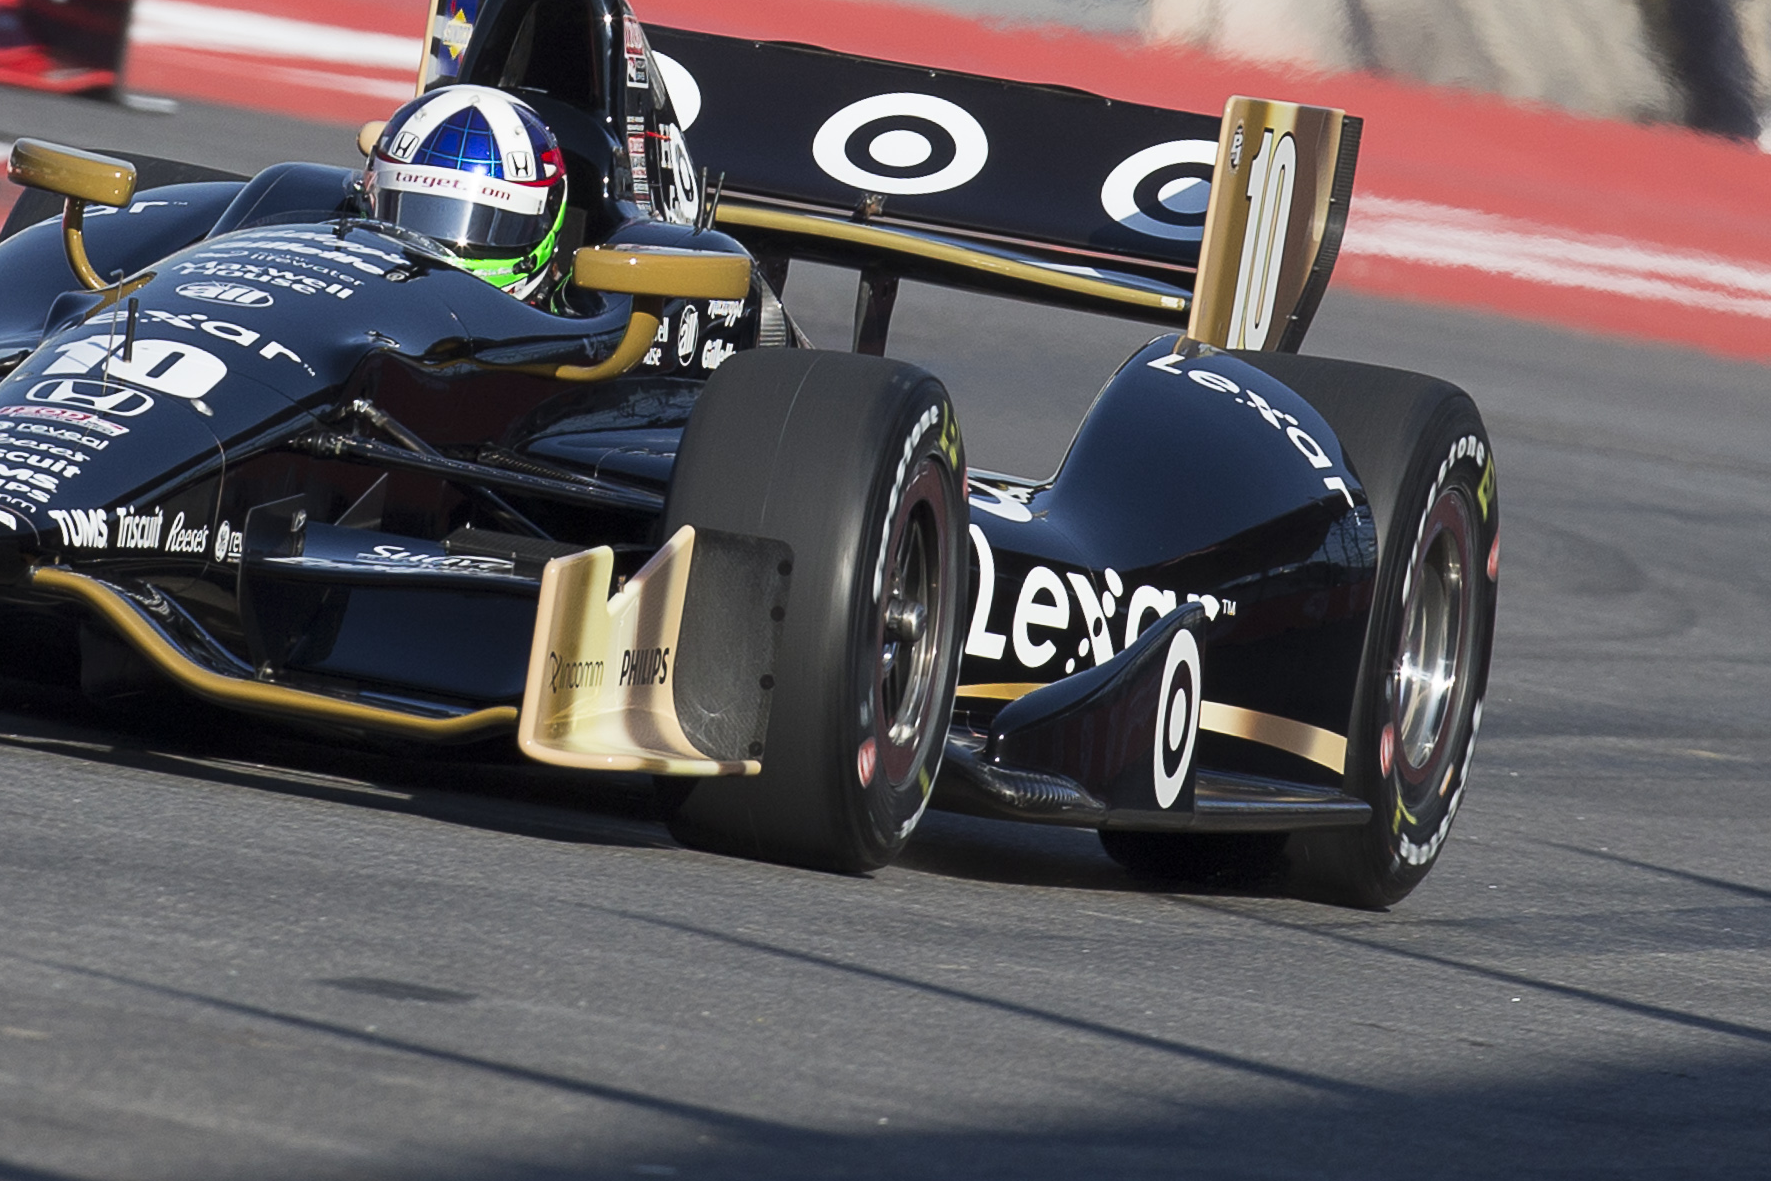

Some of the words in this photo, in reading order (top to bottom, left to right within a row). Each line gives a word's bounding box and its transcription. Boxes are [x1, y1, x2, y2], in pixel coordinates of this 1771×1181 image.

[395, 170, 512, 202] target.om
[1226, 129, 1297, 351] 10
[171, 260, 355, 300] Maxwell
[83, 309, 302, 364] exar
[41, 334, 228, 399] 10
[15, 421, 110, 451] reveal
[1146, 353, 1355, 509] Lexar
[47, 508, 108, 549] TUMS
[115, 504, 164, 549] Triscuit
[164, 511, 210, 553] Reese's
[228, 530, 244, 554] rev
[619, 646, 670, 687] PHILIPS
